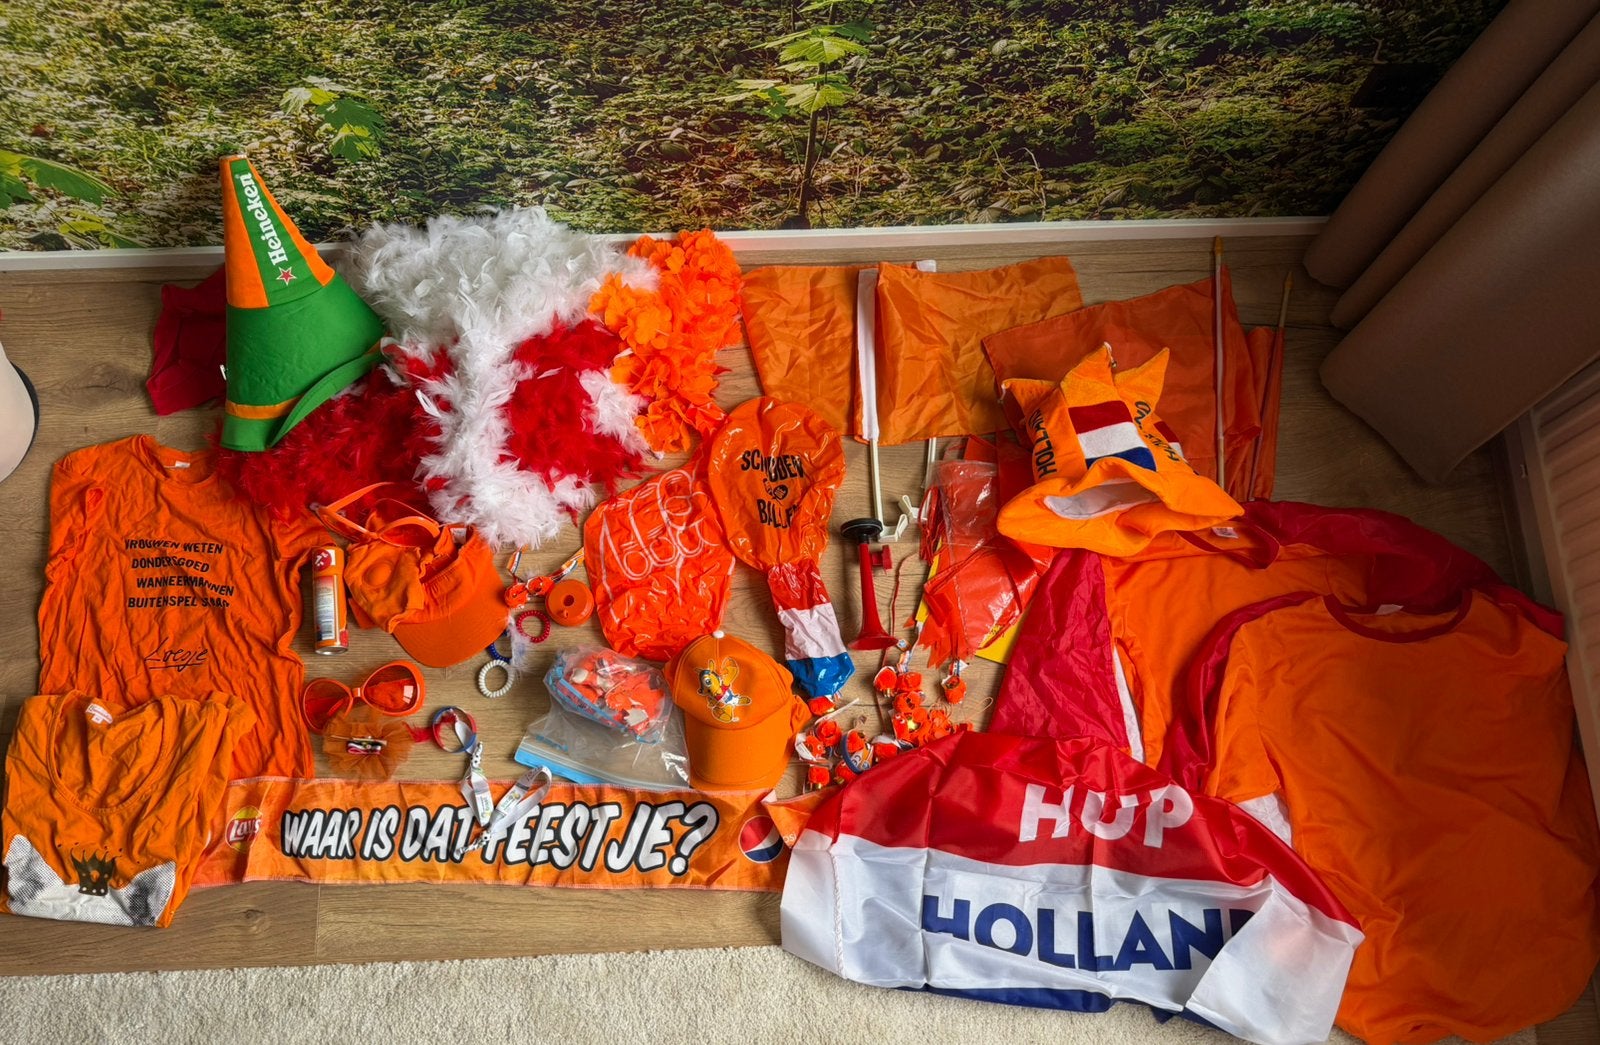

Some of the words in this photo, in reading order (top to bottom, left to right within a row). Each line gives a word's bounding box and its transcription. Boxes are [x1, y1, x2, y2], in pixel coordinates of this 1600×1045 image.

[240, 172, 289, 266] Heineken
[125, 539, 180, 550] VROUWEN
[183, 542, 224, 554] WETEN
[131, 556, 210, 573] DONDERSGOED
[127, 596, 197, 608] BUITENSPEL
[144, 636, 208, 672] Loesje
[282, 809, 362, 859] WAAR
[363, 807, 401, 861] IS
[402, 804, 477, 864] DAT
[1018, 783, 1194, 849] HUP
